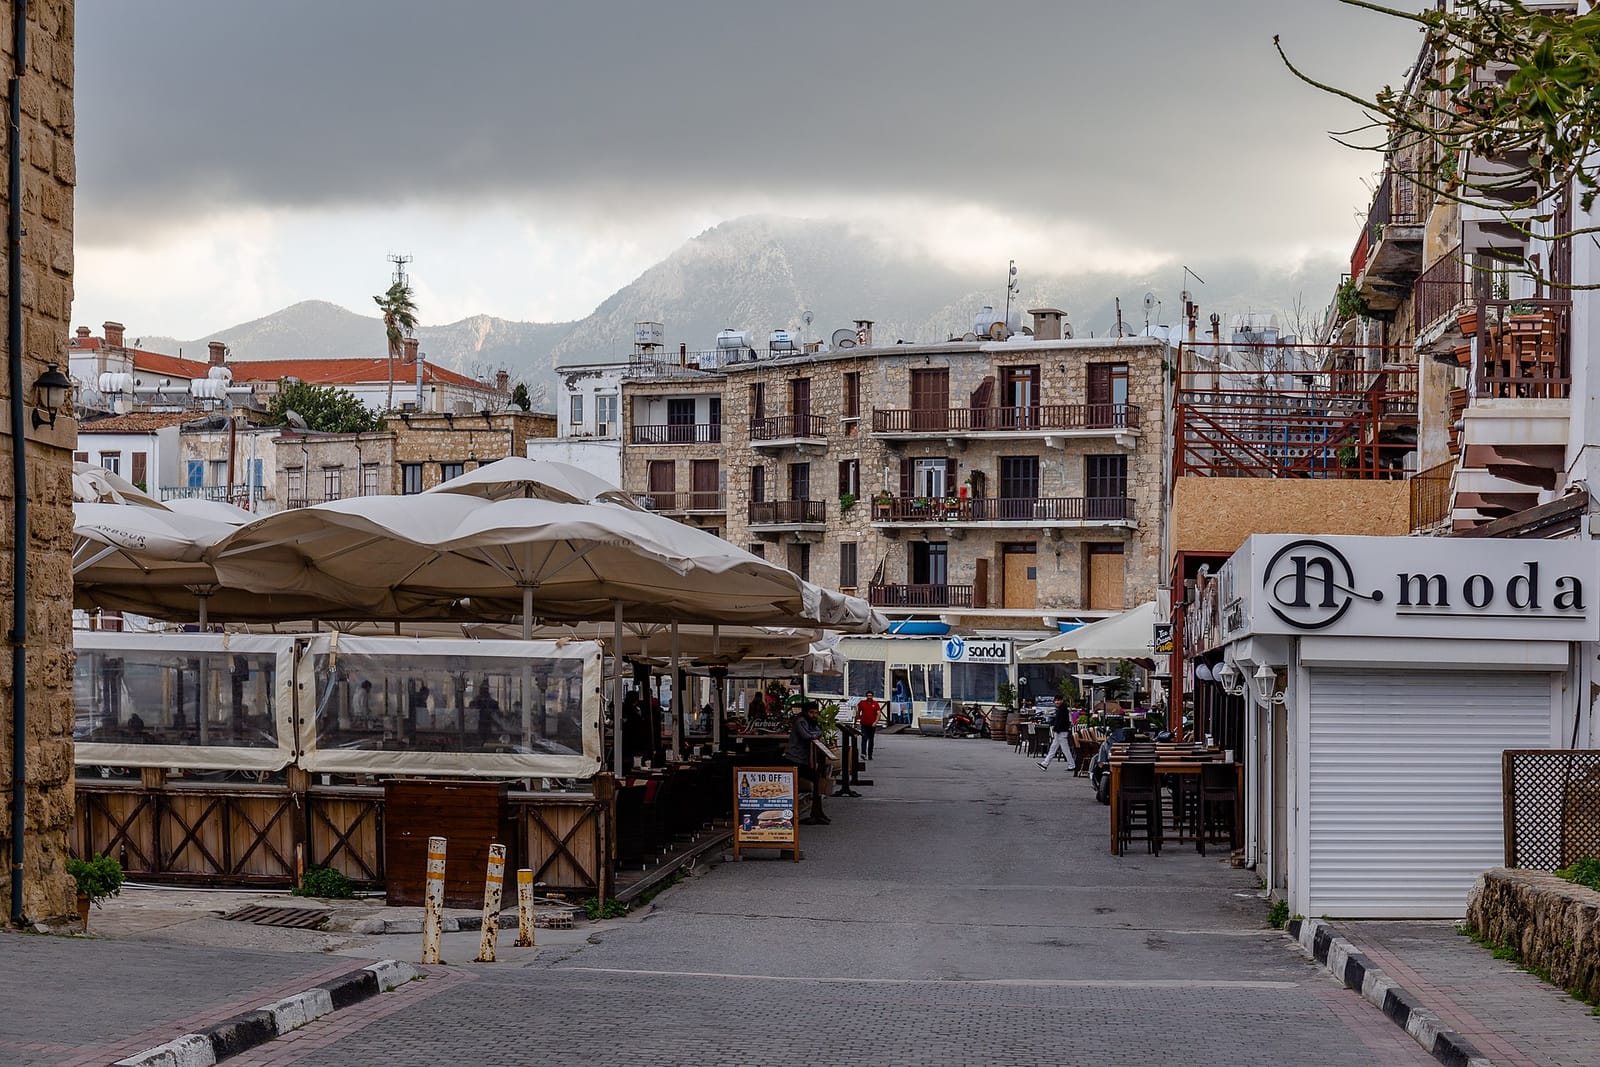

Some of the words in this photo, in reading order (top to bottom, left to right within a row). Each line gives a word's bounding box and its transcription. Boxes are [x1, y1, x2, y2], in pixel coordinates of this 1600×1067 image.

[1397, 561, 1586, 611] moda
[968, 643, 1006, 657] sandal
[758, 774, 766, 782] 10
[768, 774, 782, 782] OFF
